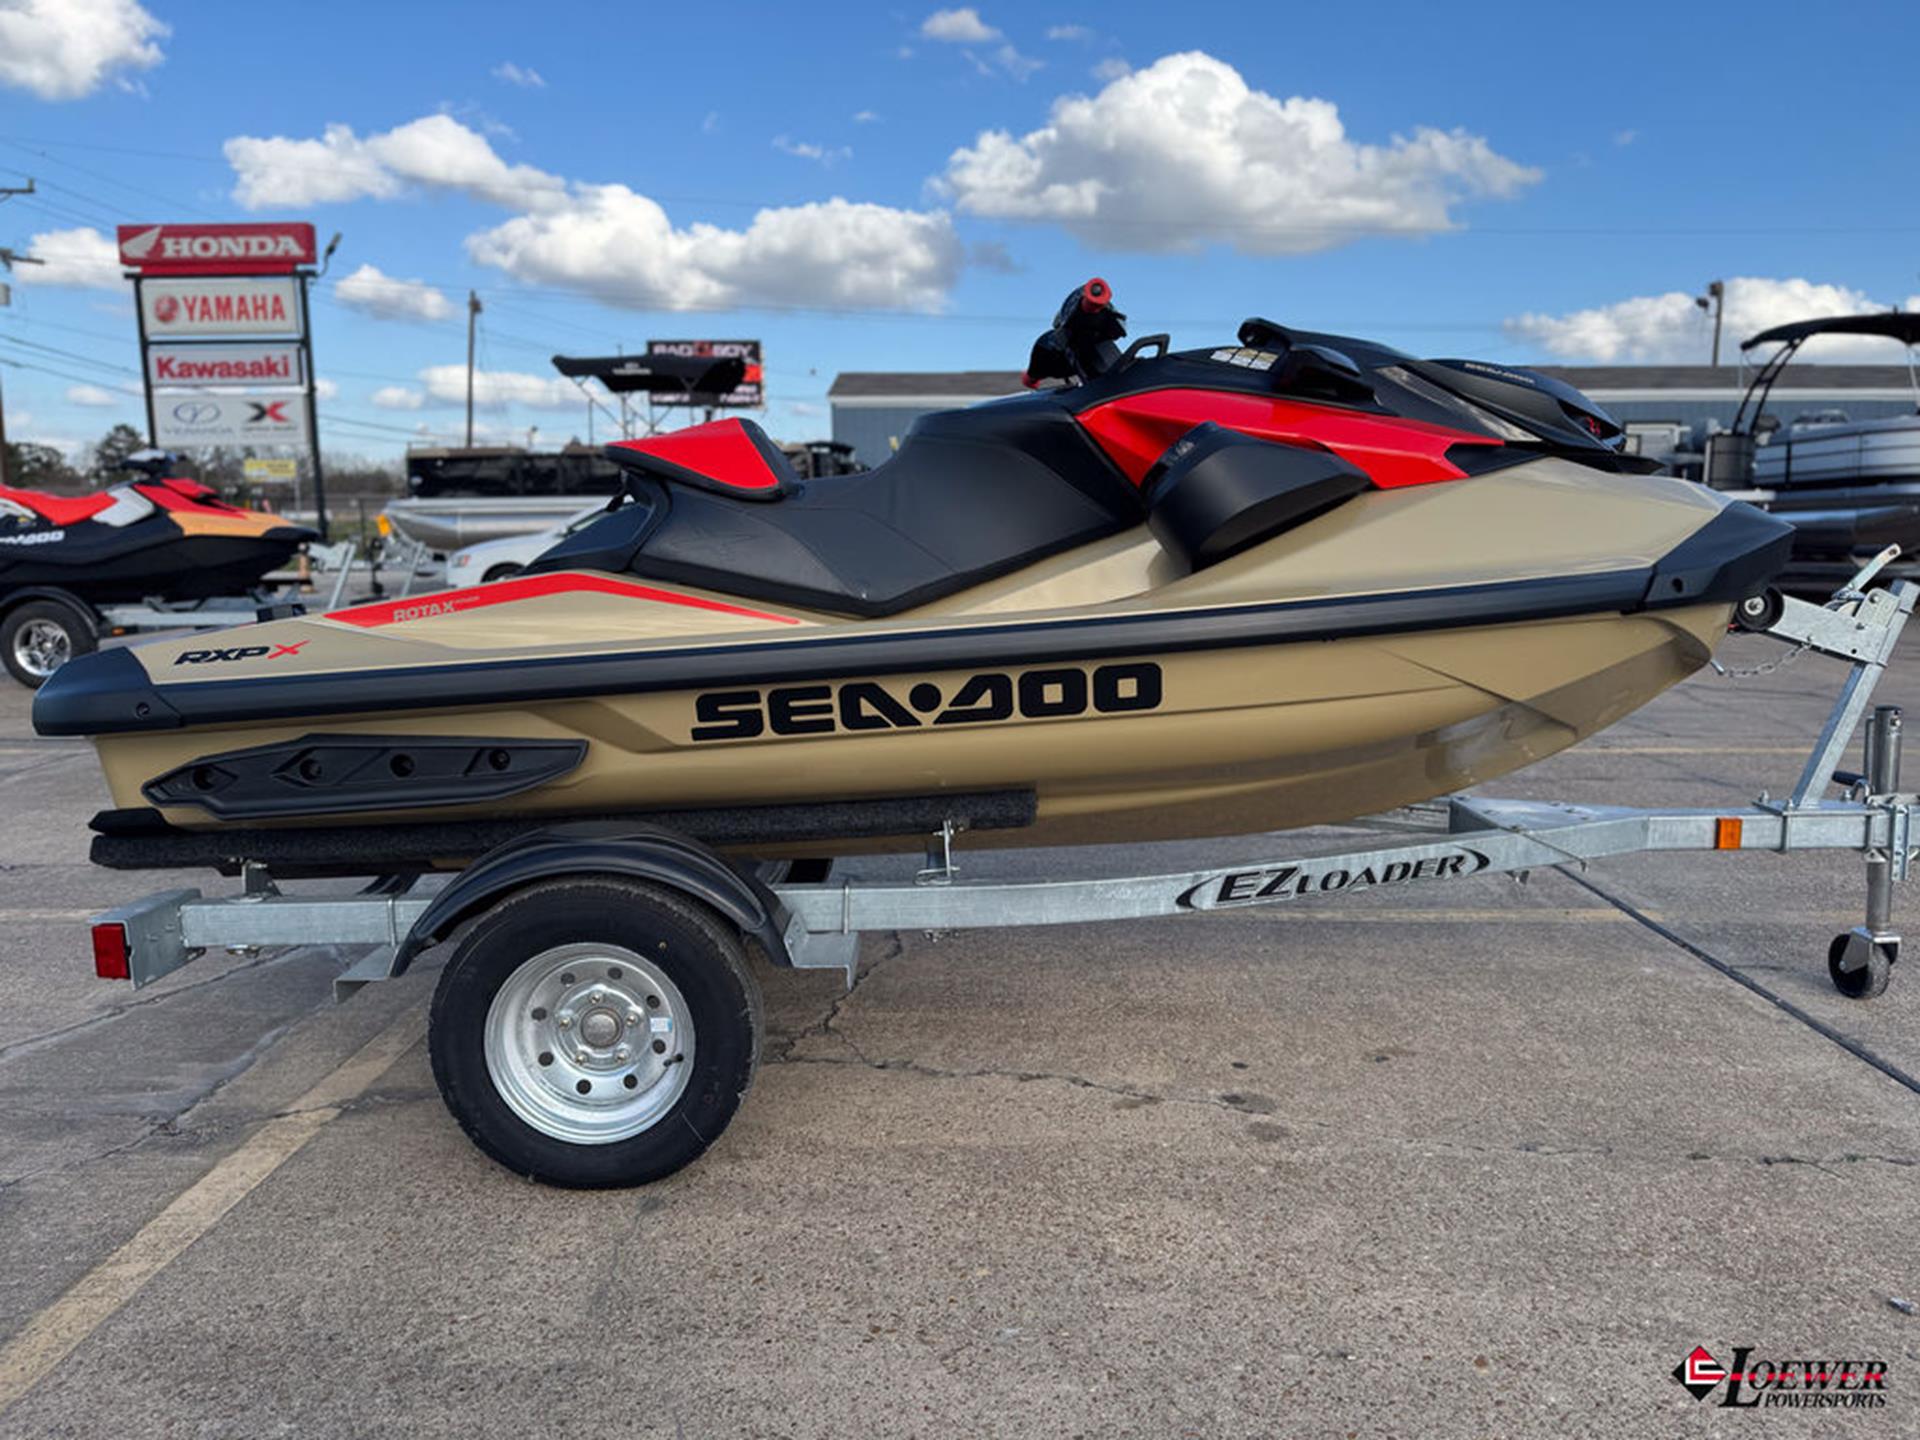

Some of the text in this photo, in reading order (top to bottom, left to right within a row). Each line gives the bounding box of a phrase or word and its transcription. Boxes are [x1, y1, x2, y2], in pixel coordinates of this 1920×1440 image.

[162, 236, 305, 258] HONDA
[182, 295, 286, 322] YAMAHA
[156, 354, 290, 379] Kawasaki
[393, 600, 456, 623] ROTAX
